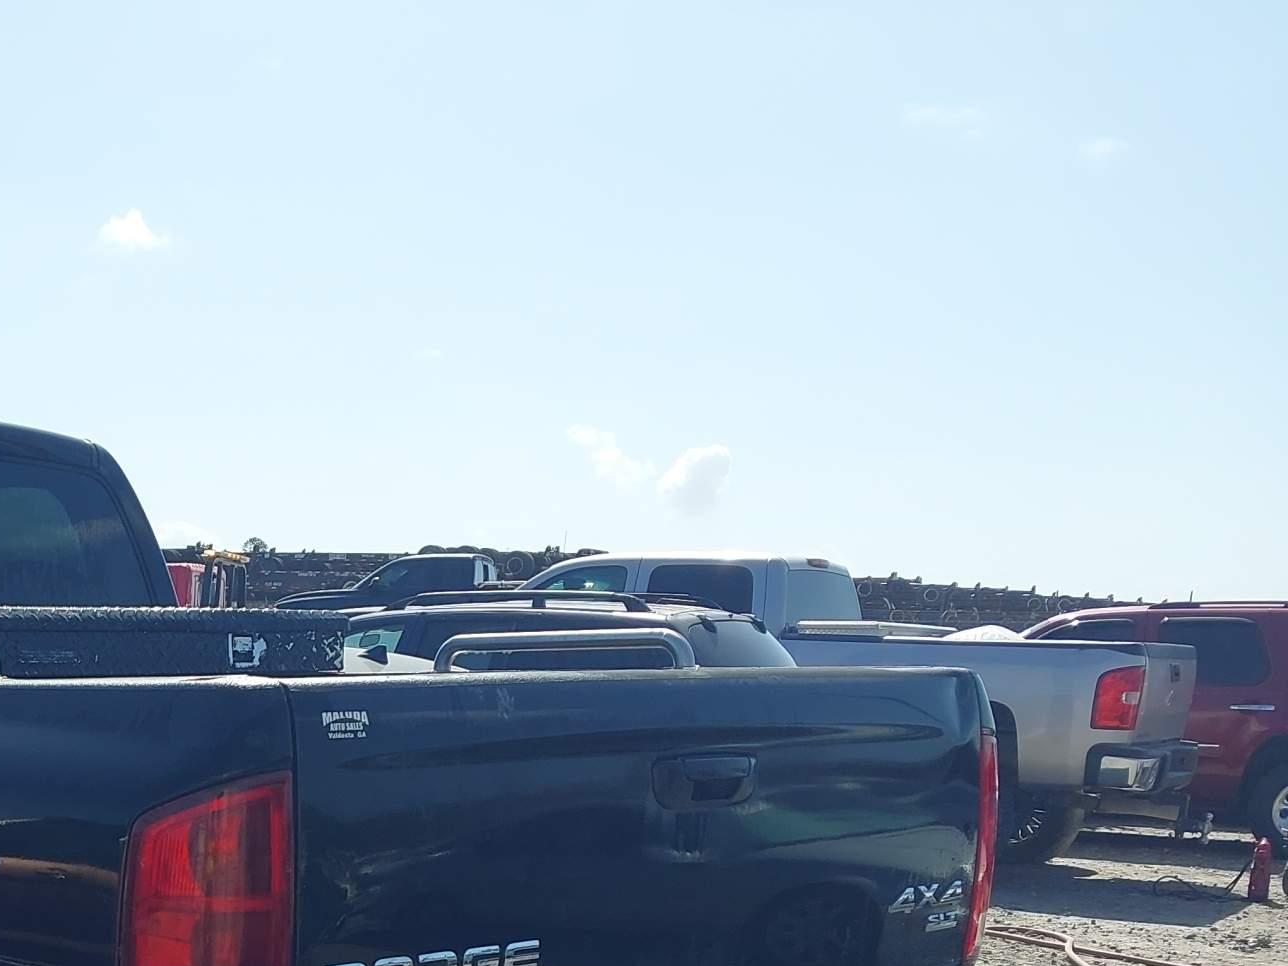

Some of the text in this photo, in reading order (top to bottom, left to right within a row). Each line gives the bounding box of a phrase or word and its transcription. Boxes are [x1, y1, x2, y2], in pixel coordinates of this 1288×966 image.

[329, 722, 363, 732] AUTO SALES
[888, 880, 964, 914] 4X4
